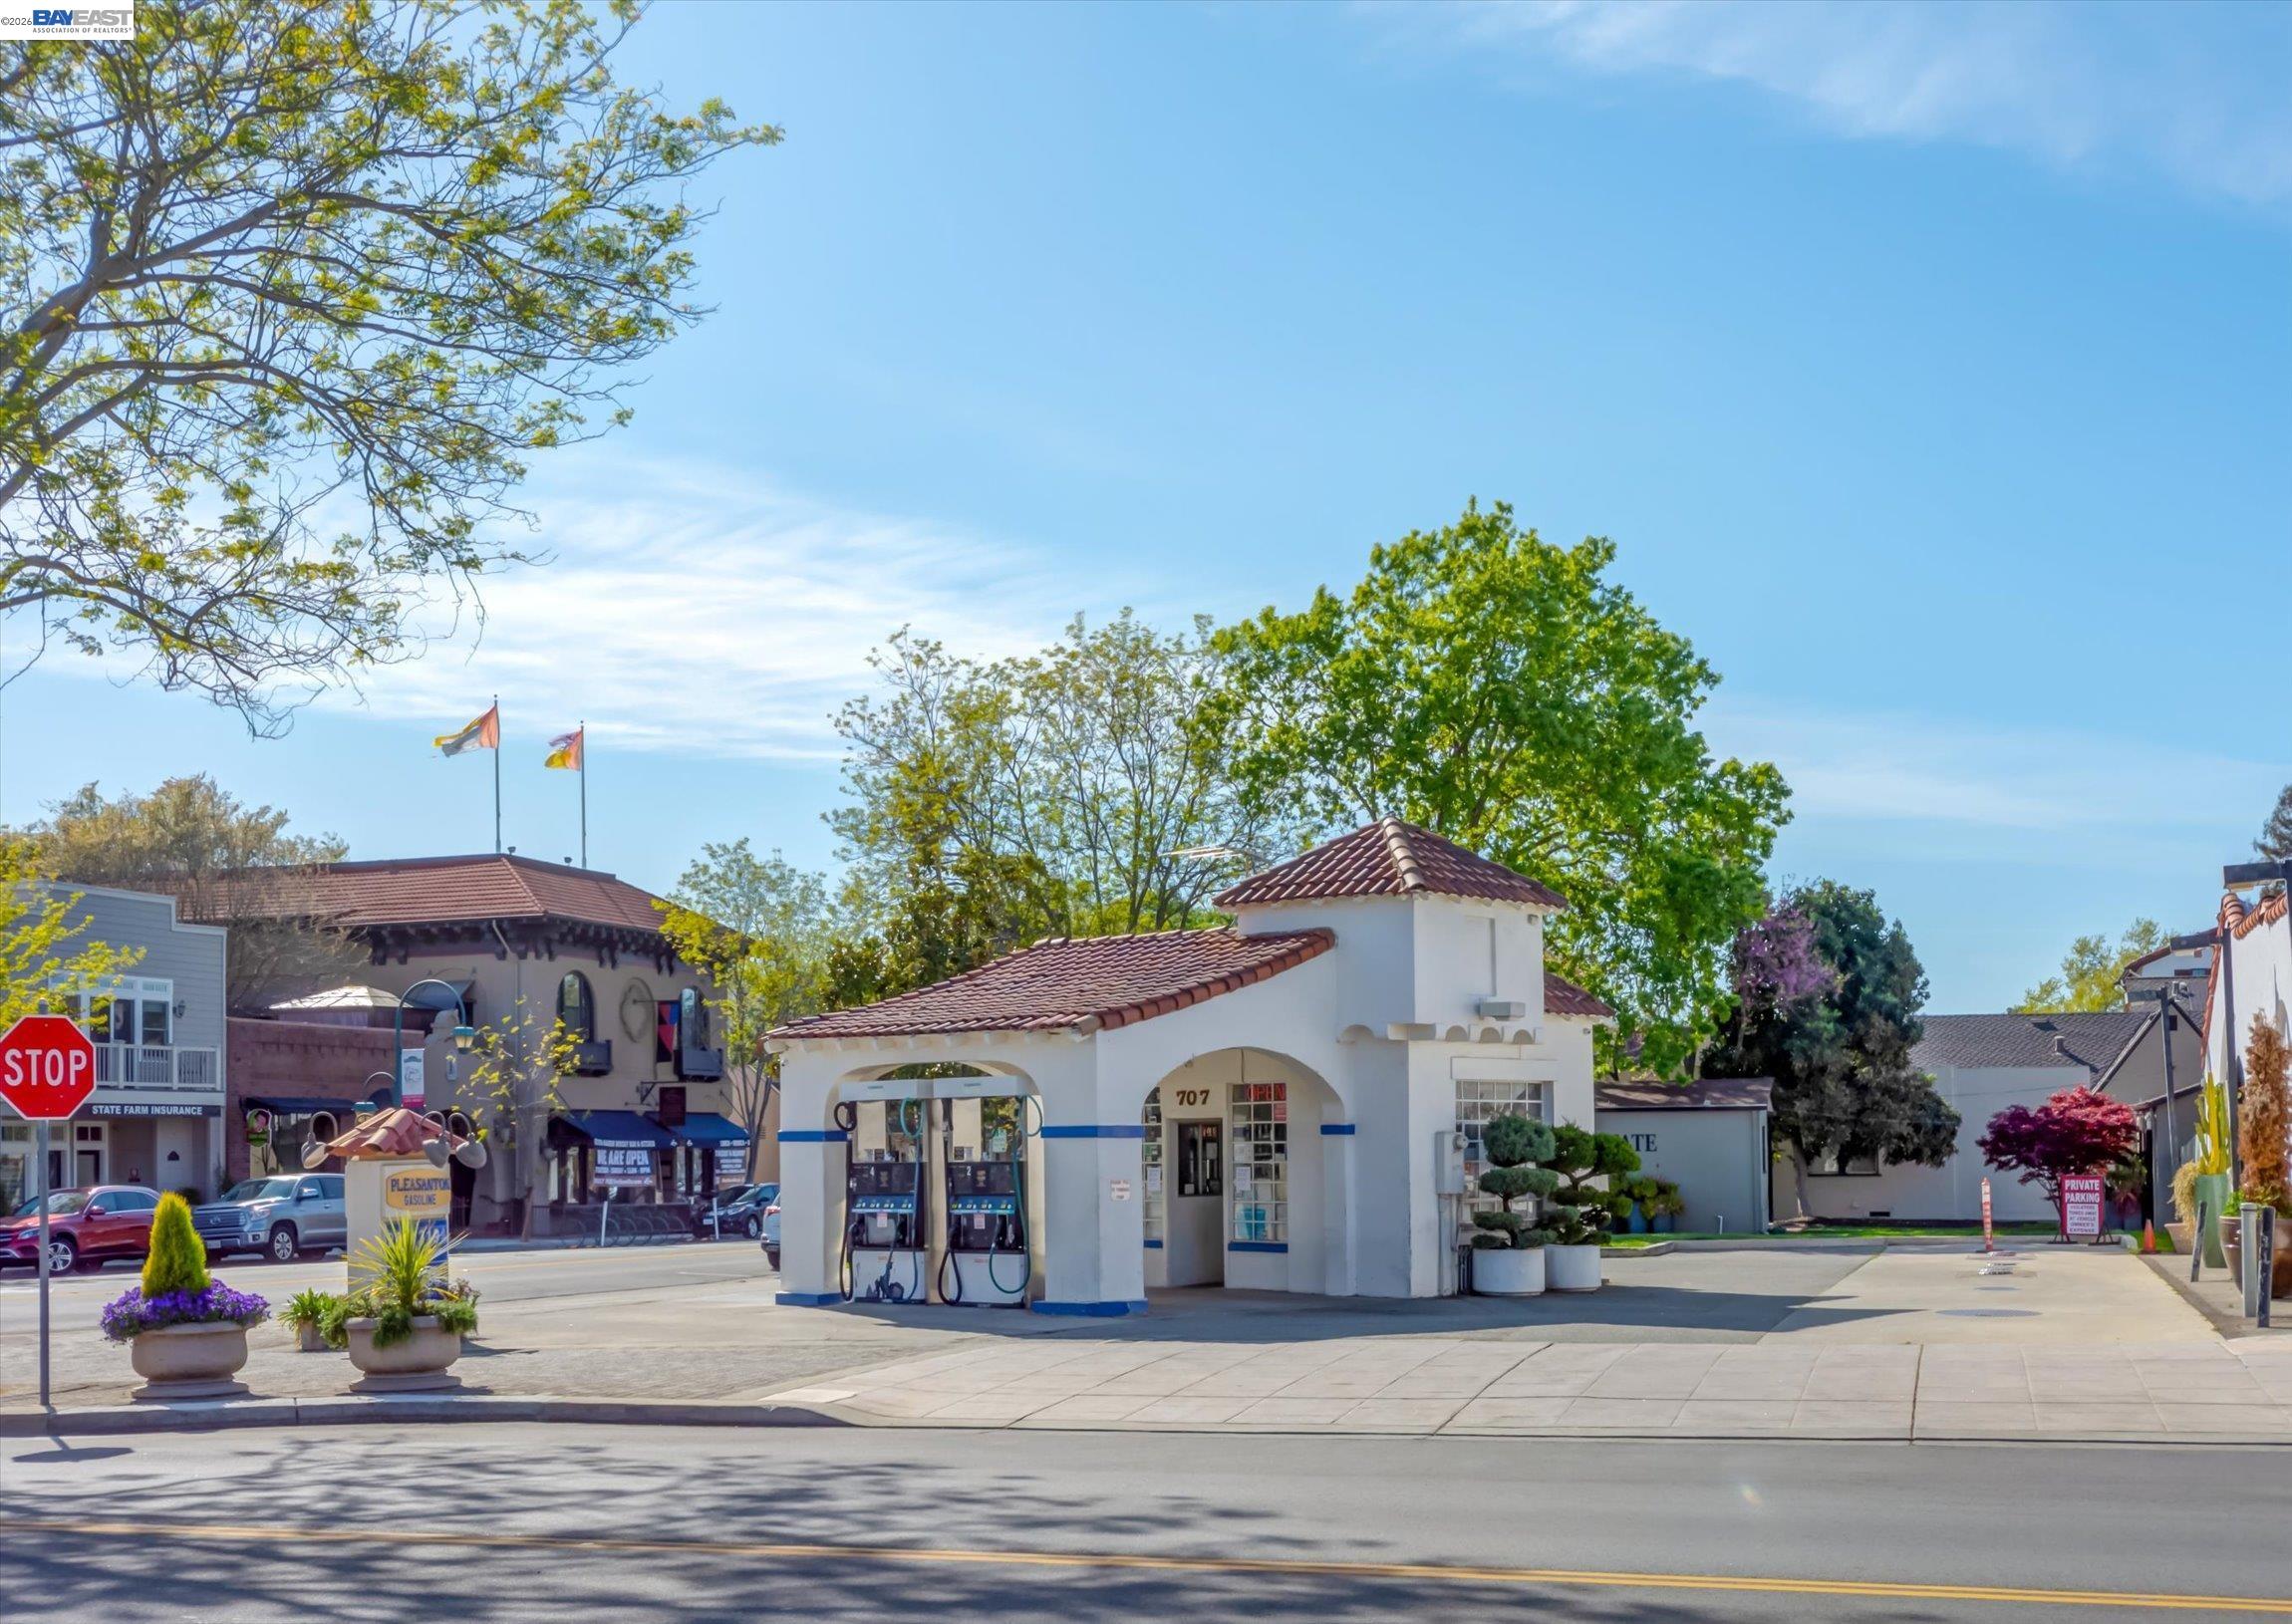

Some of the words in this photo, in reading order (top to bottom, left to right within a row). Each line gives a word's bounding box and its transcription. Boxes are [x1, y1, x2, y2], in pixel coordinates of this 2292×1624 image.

[4, 1048, 87, 1086] STOP
[1176, 1089, 1210, 1106] 707
[1247, 1083, 1286, 1101] OPEN
[92, 1105, 122, 1115] STATE
[124, 1105, 148, 1115] FARM
[150, 1106, 203, 1116] INSURANCE
[597, 1149, 608, 1166] WE
[608, 1149, 625, 1166] ARE
[626, 1149, 650, 1166] OPEN
[869, 1166, 875, 1176] 4
[967, 1166, 972, 1176] 2
[2065, 1180, 2100, 1191] PRIVATE
[404, 1195, 436, 1206] GASOLINE
[2065, 1193, 2100, 1204] PARKING
